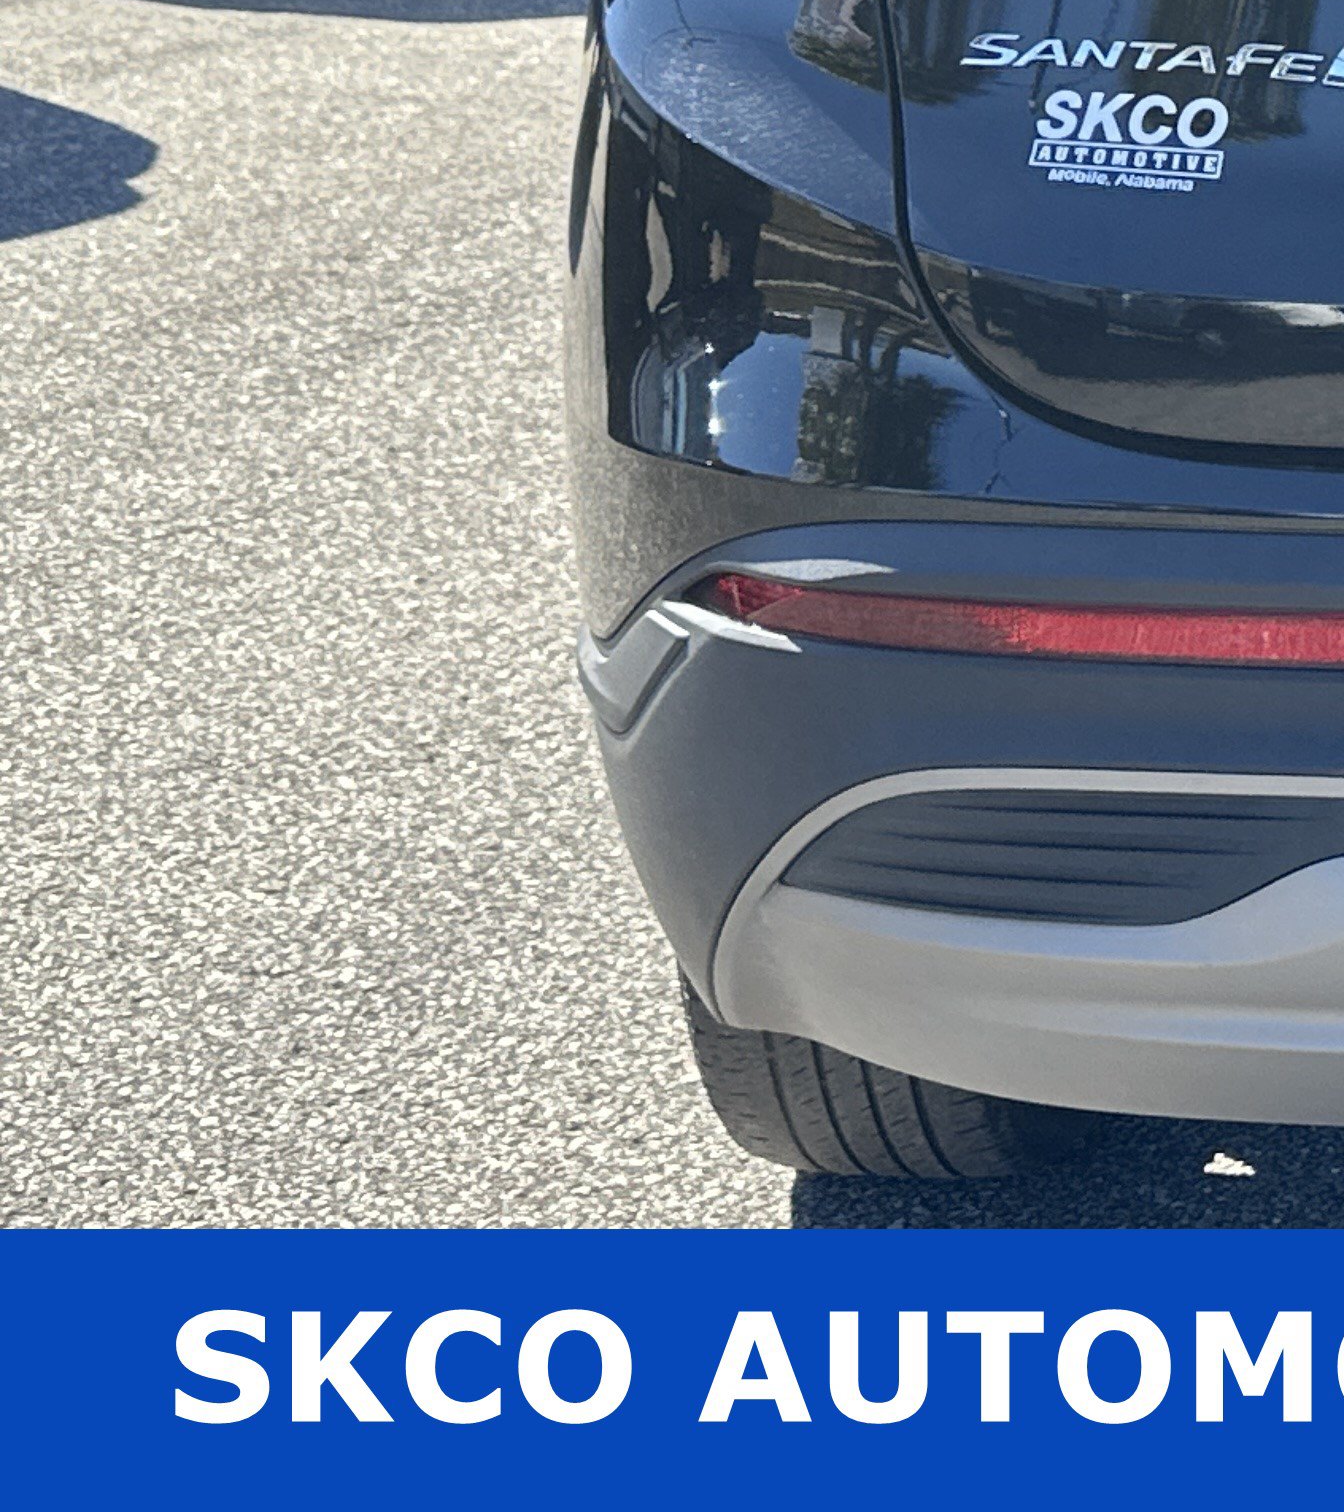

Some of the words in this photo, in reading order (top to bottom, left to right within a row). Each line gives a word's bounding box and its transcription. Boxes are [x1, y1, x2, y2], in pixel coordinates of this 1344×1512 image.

[1036, 89, 1229, 148] SKCO
[1036, 145, 1218, 174] AUTOMOTIVE
[1115, 173, 1194, 192] Alabama
